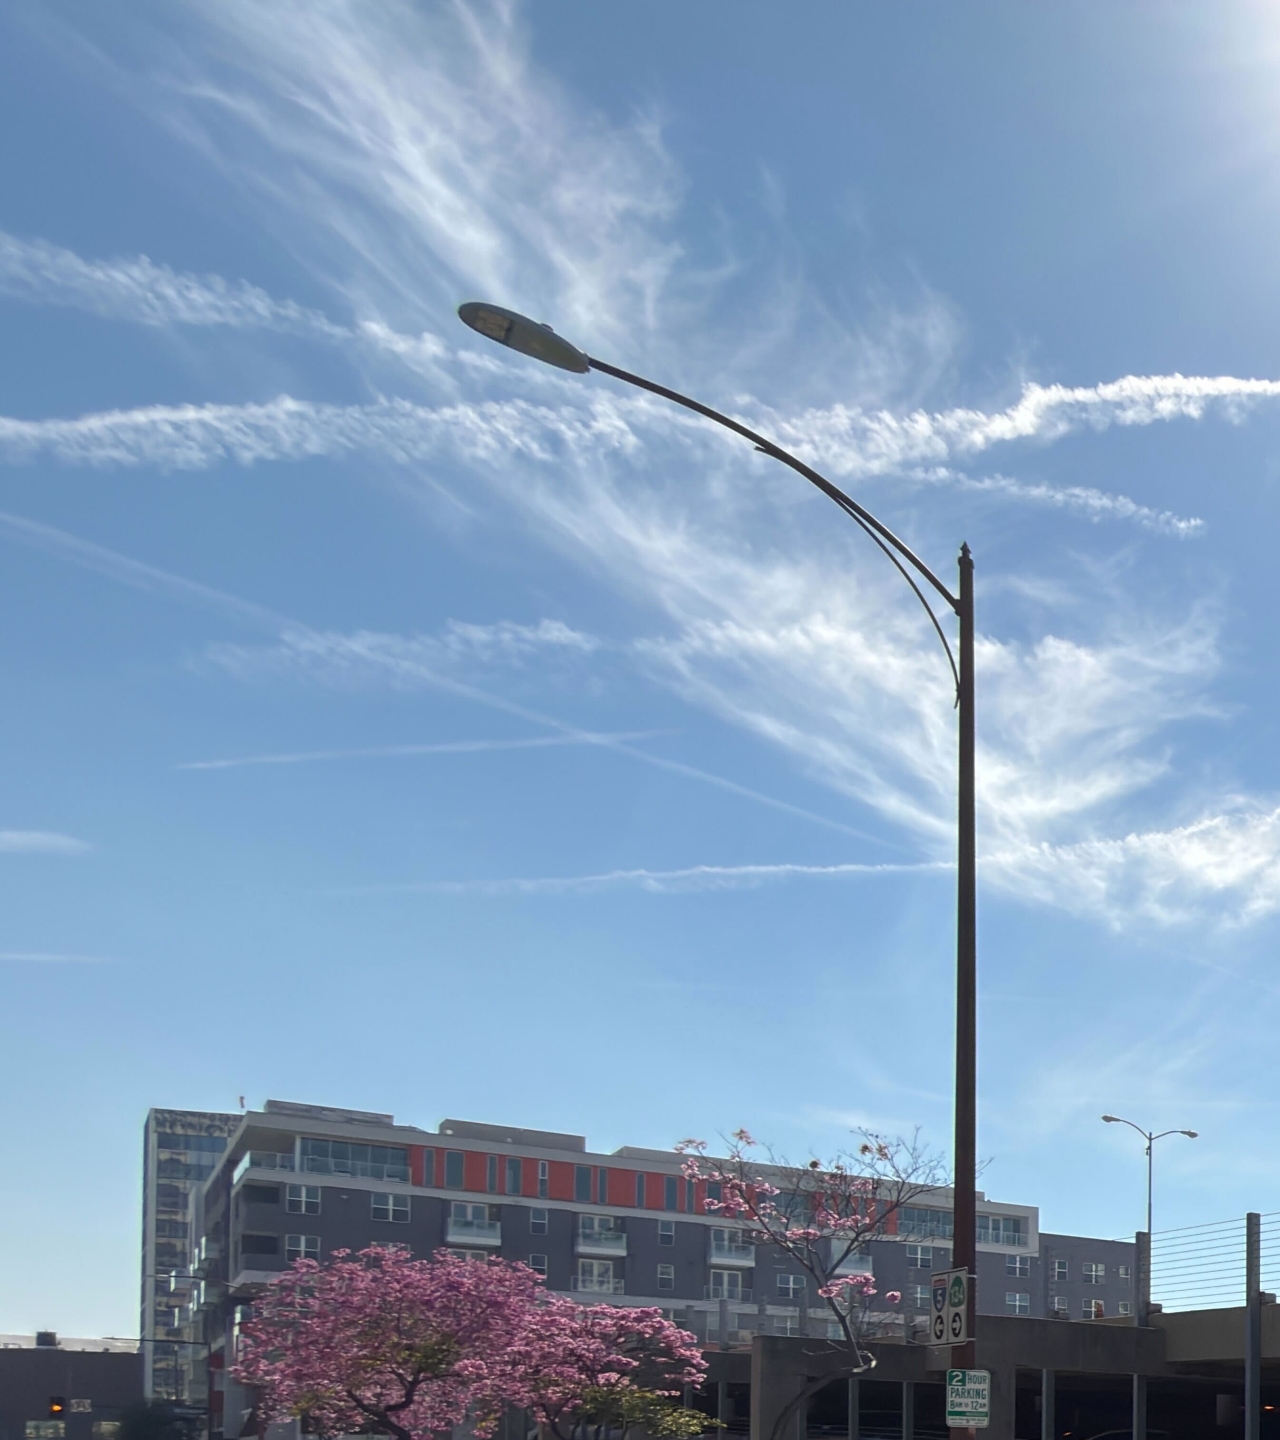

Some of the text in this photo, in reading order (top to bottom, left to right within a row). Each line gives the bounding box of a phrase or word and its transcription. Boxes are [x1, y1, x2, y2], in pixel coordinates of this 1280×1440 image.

[936, 1289, 943, 1309] 5
[951, 1371, 987, 1386] 2 HOUR
[950, 1387, 987, 1400] PARKING
